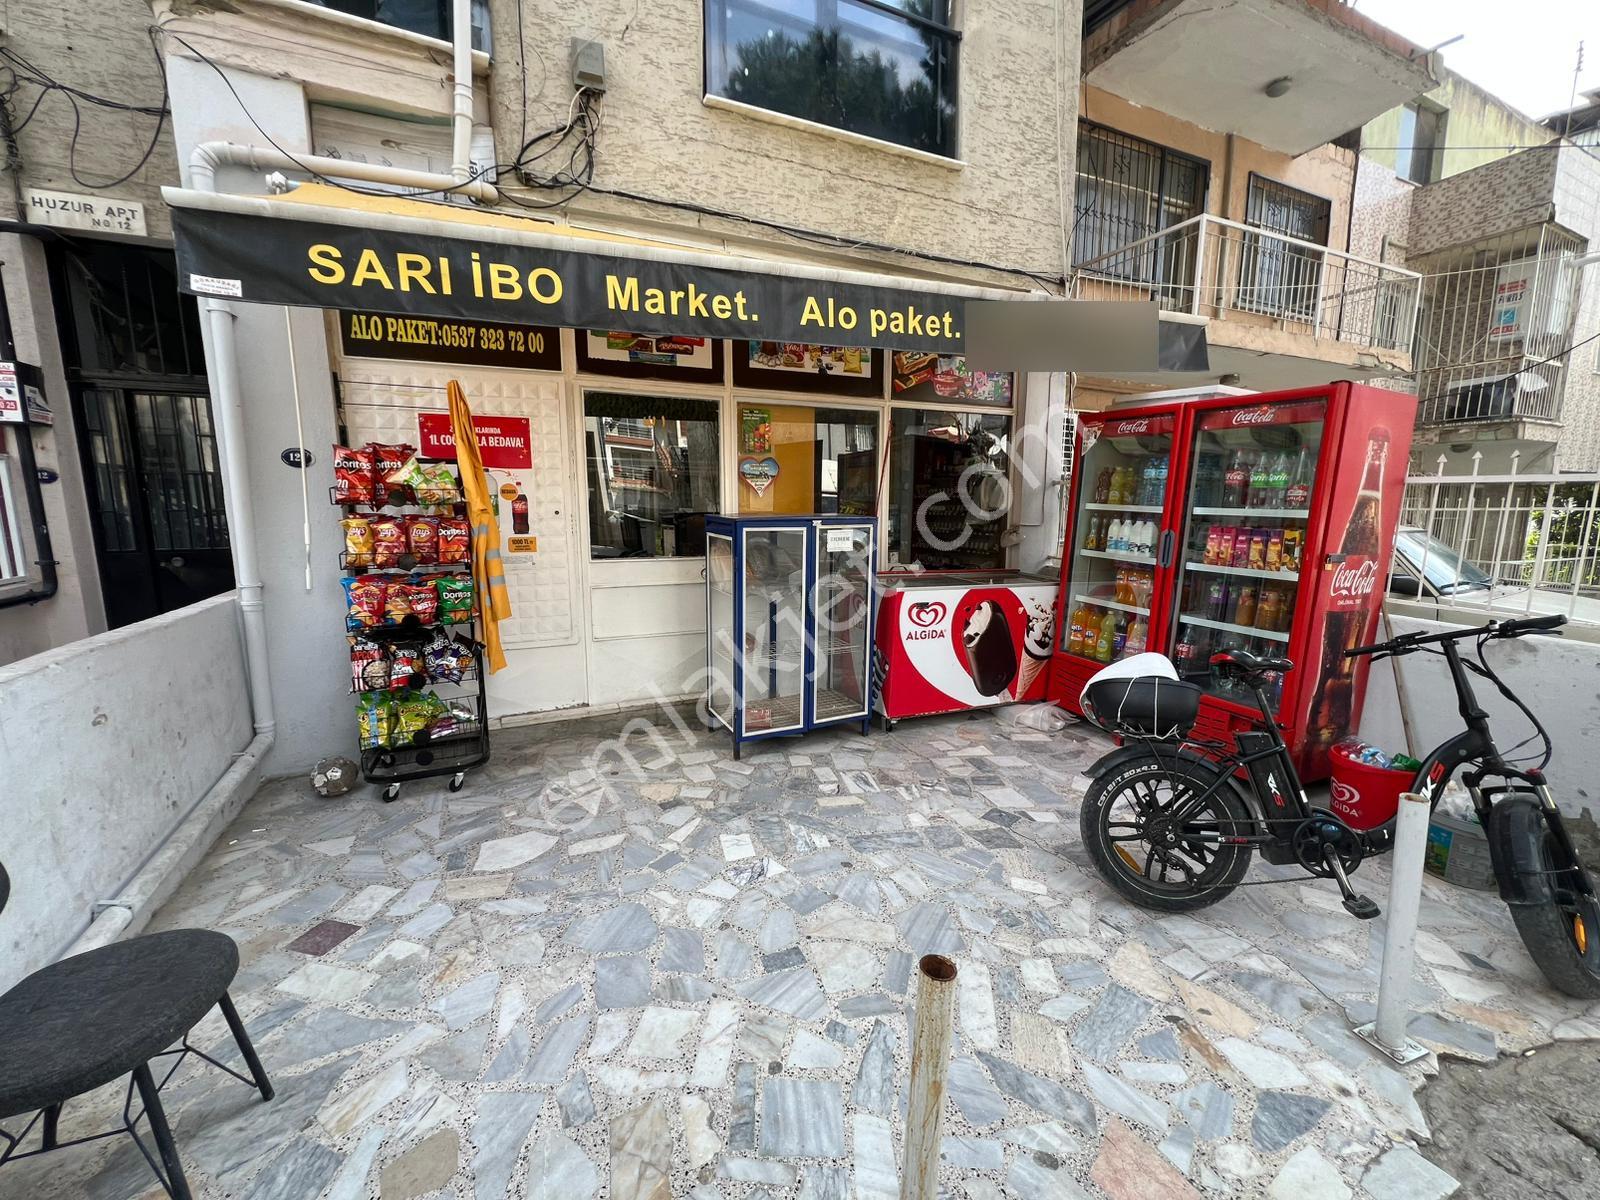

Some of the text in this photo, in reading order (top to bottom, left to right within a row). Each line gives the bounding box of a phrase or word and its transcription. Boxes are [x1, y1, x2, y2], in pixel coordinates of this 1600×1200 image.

[31, 196, 94, 214] HUZUR
[118, 221, 132, 230] 12
[308, 244, 961, 339] SARI İBO Market. Alo paket.
[350, 314, 545, 354] ALO PAKET:0537 323 72 00
[1231, 407, 1276, 425] Coca-Cola
[1117, 419, 1149, 434] Coca-Cola
[428, 434, 440, 446] 1L
[488, 436, 524, 448] BEDAVA!
[289, 452, 301, 462] 12
[334, 459, 372, 470] Doritos
[376, 460, 403, 470] oritos
[437, 527, 467, 537] Doritos
[1330, 559, 1379, 597] Coca-Cola
[442, 590, 473, 601] Doritos
[1123, 764, 1159, 779] 20x4.0
